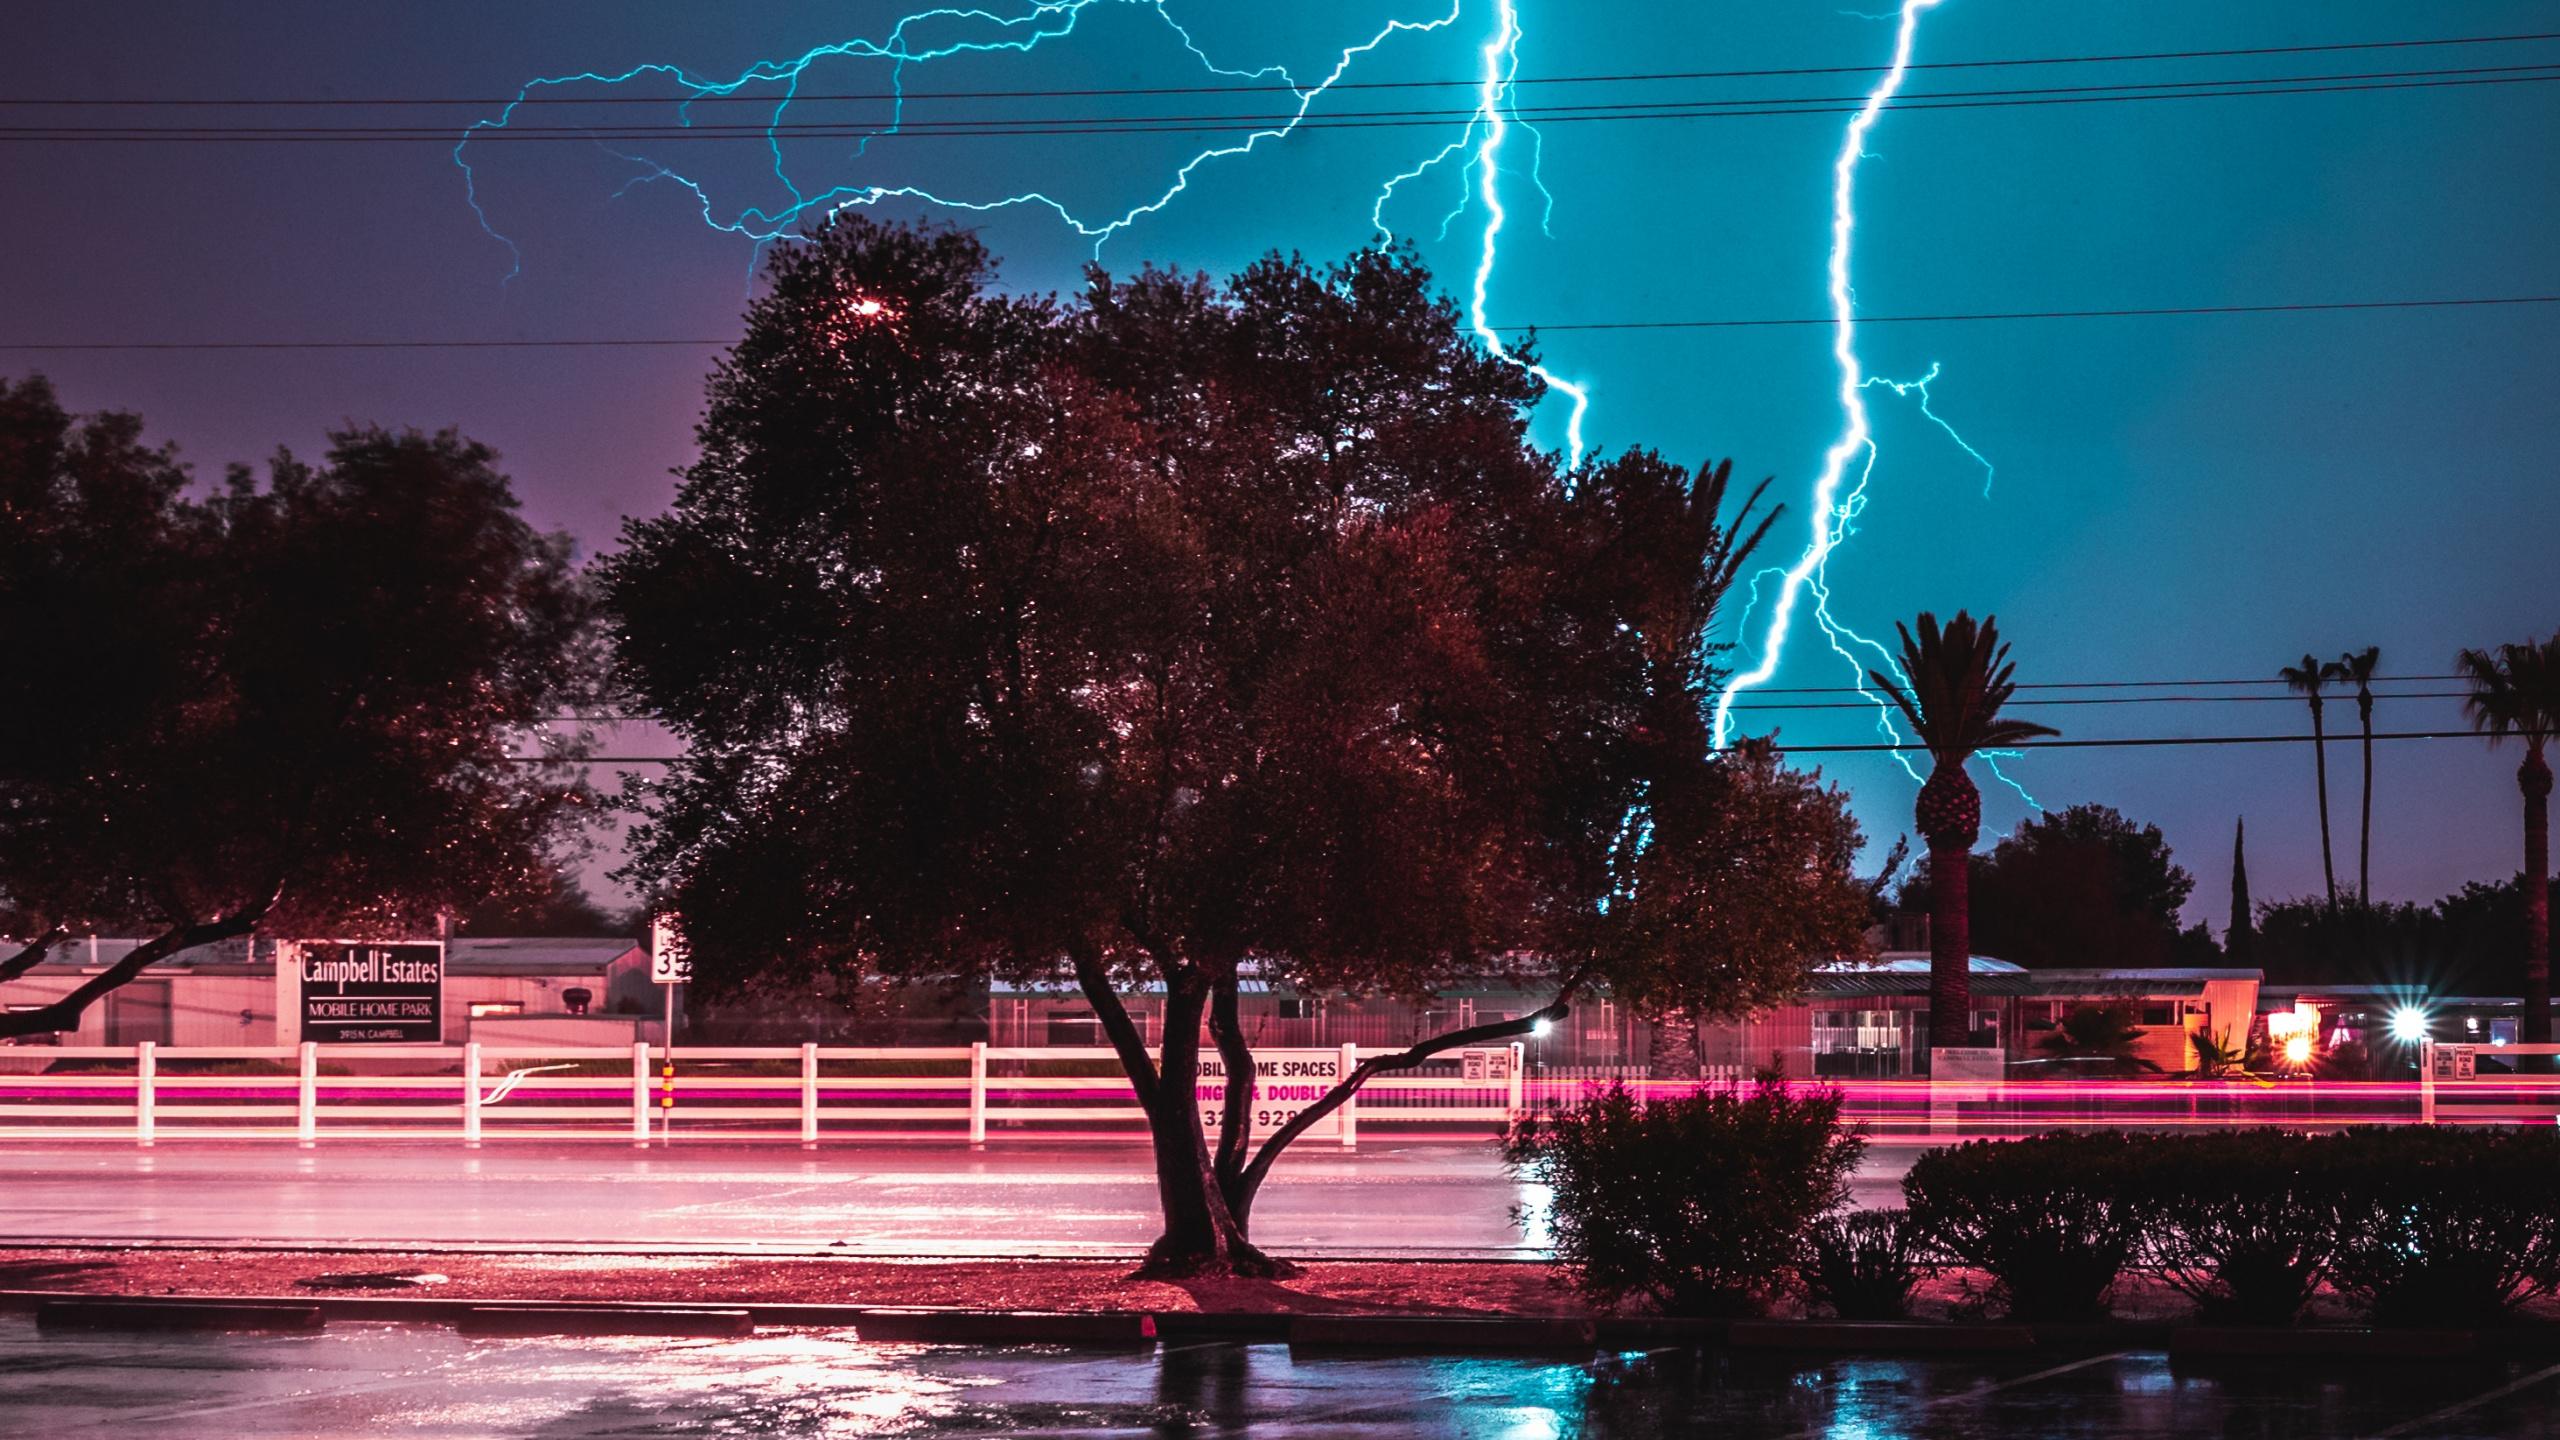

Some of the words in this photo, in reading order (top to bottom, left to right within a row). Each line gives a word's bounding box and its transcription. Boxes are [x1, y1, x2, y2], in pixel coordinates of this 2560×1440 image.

[302, 949, 379, 995] Campbell
[382, 952, 438, 983] Estates
[309, 1003, 357, 1017] MOBILE
[360, 1003, 399, 1016] HOME
[401, 1003, 433, 1016] PARK
[367, 1029, 404, 1038] CAMPBELL
[1282, 1062, 1336, 1077] SPACES
